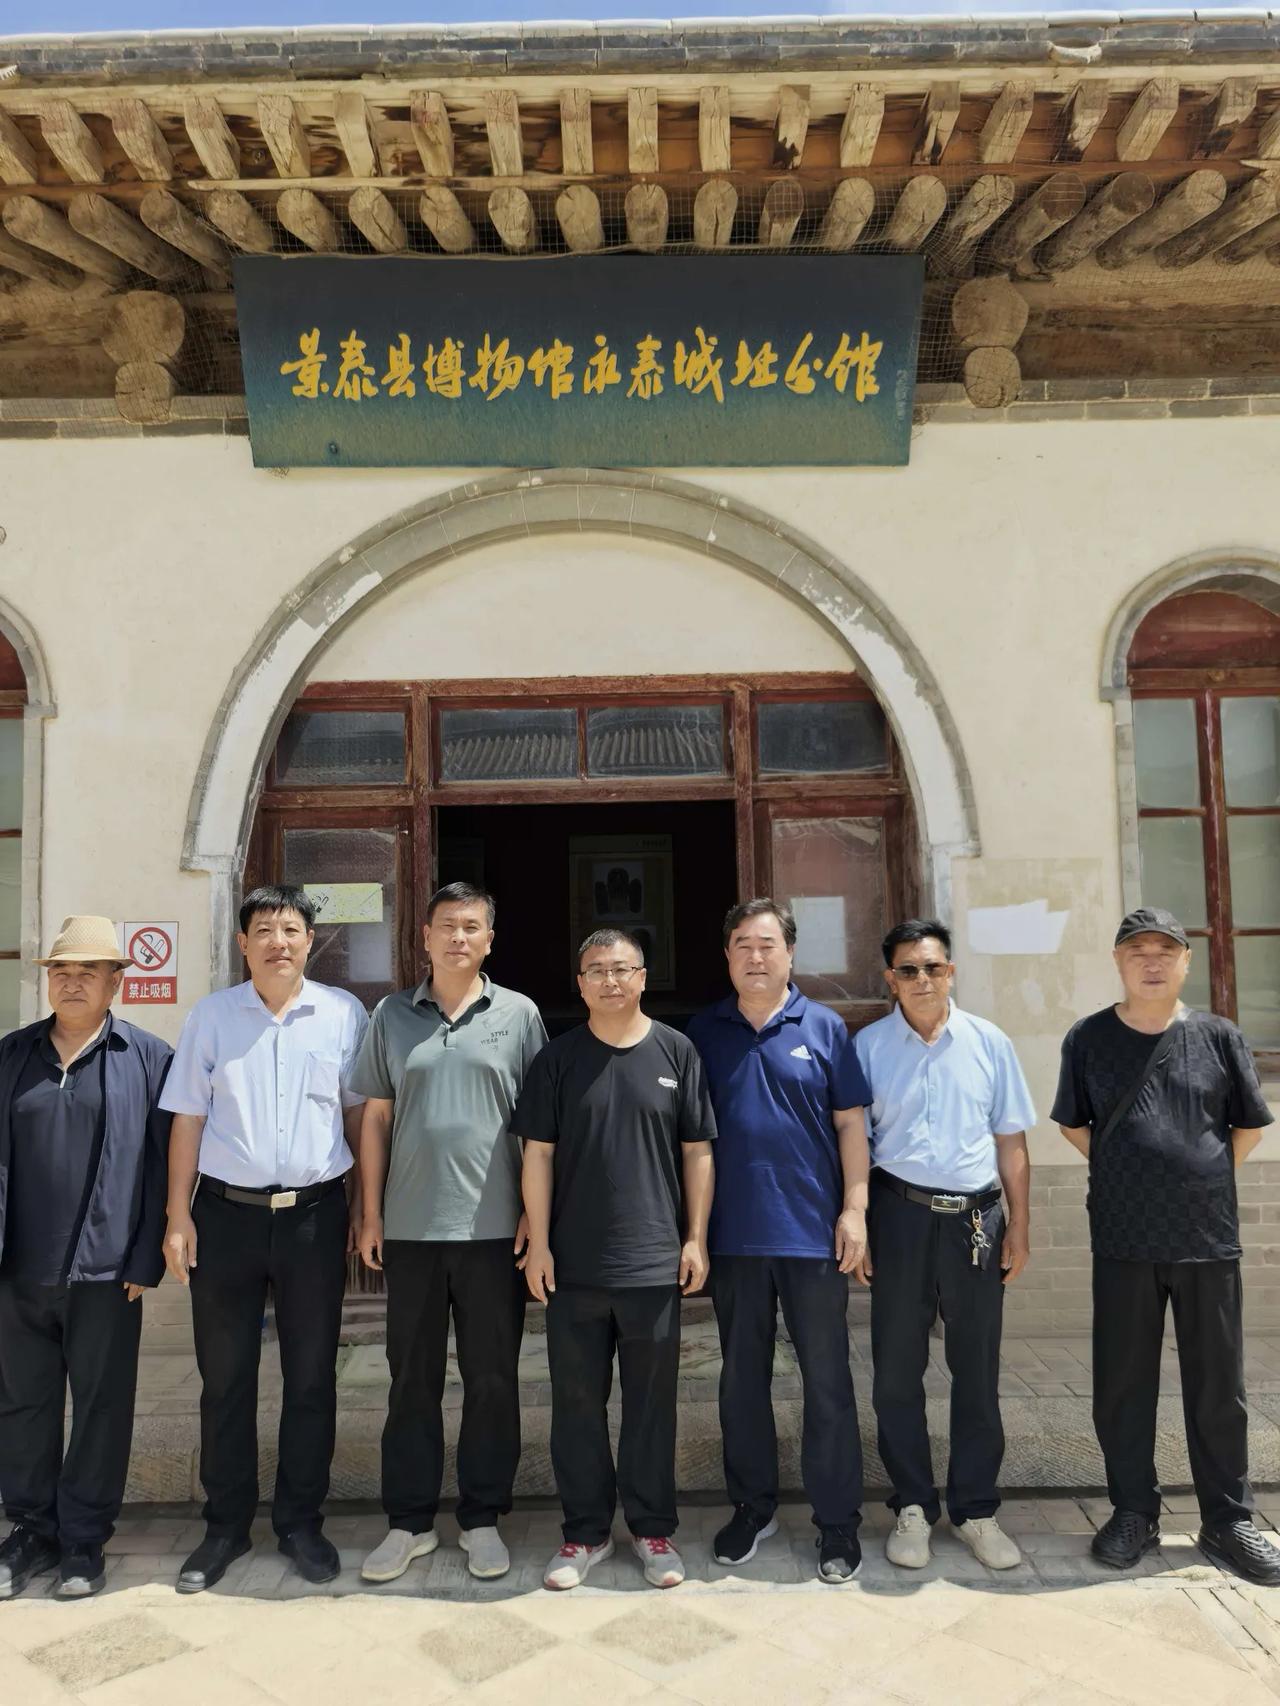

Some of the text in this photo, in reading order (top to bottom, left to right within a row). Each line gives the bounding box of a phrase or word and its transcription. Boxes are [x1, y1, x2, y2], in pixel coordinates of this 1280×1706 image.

[280, 326, 884, 403] 景泰县博物馆永泰城址分馆
[128, 982, 172, 998] 禁止吸烟
[490, 1030, 509, 1038] STYLE
